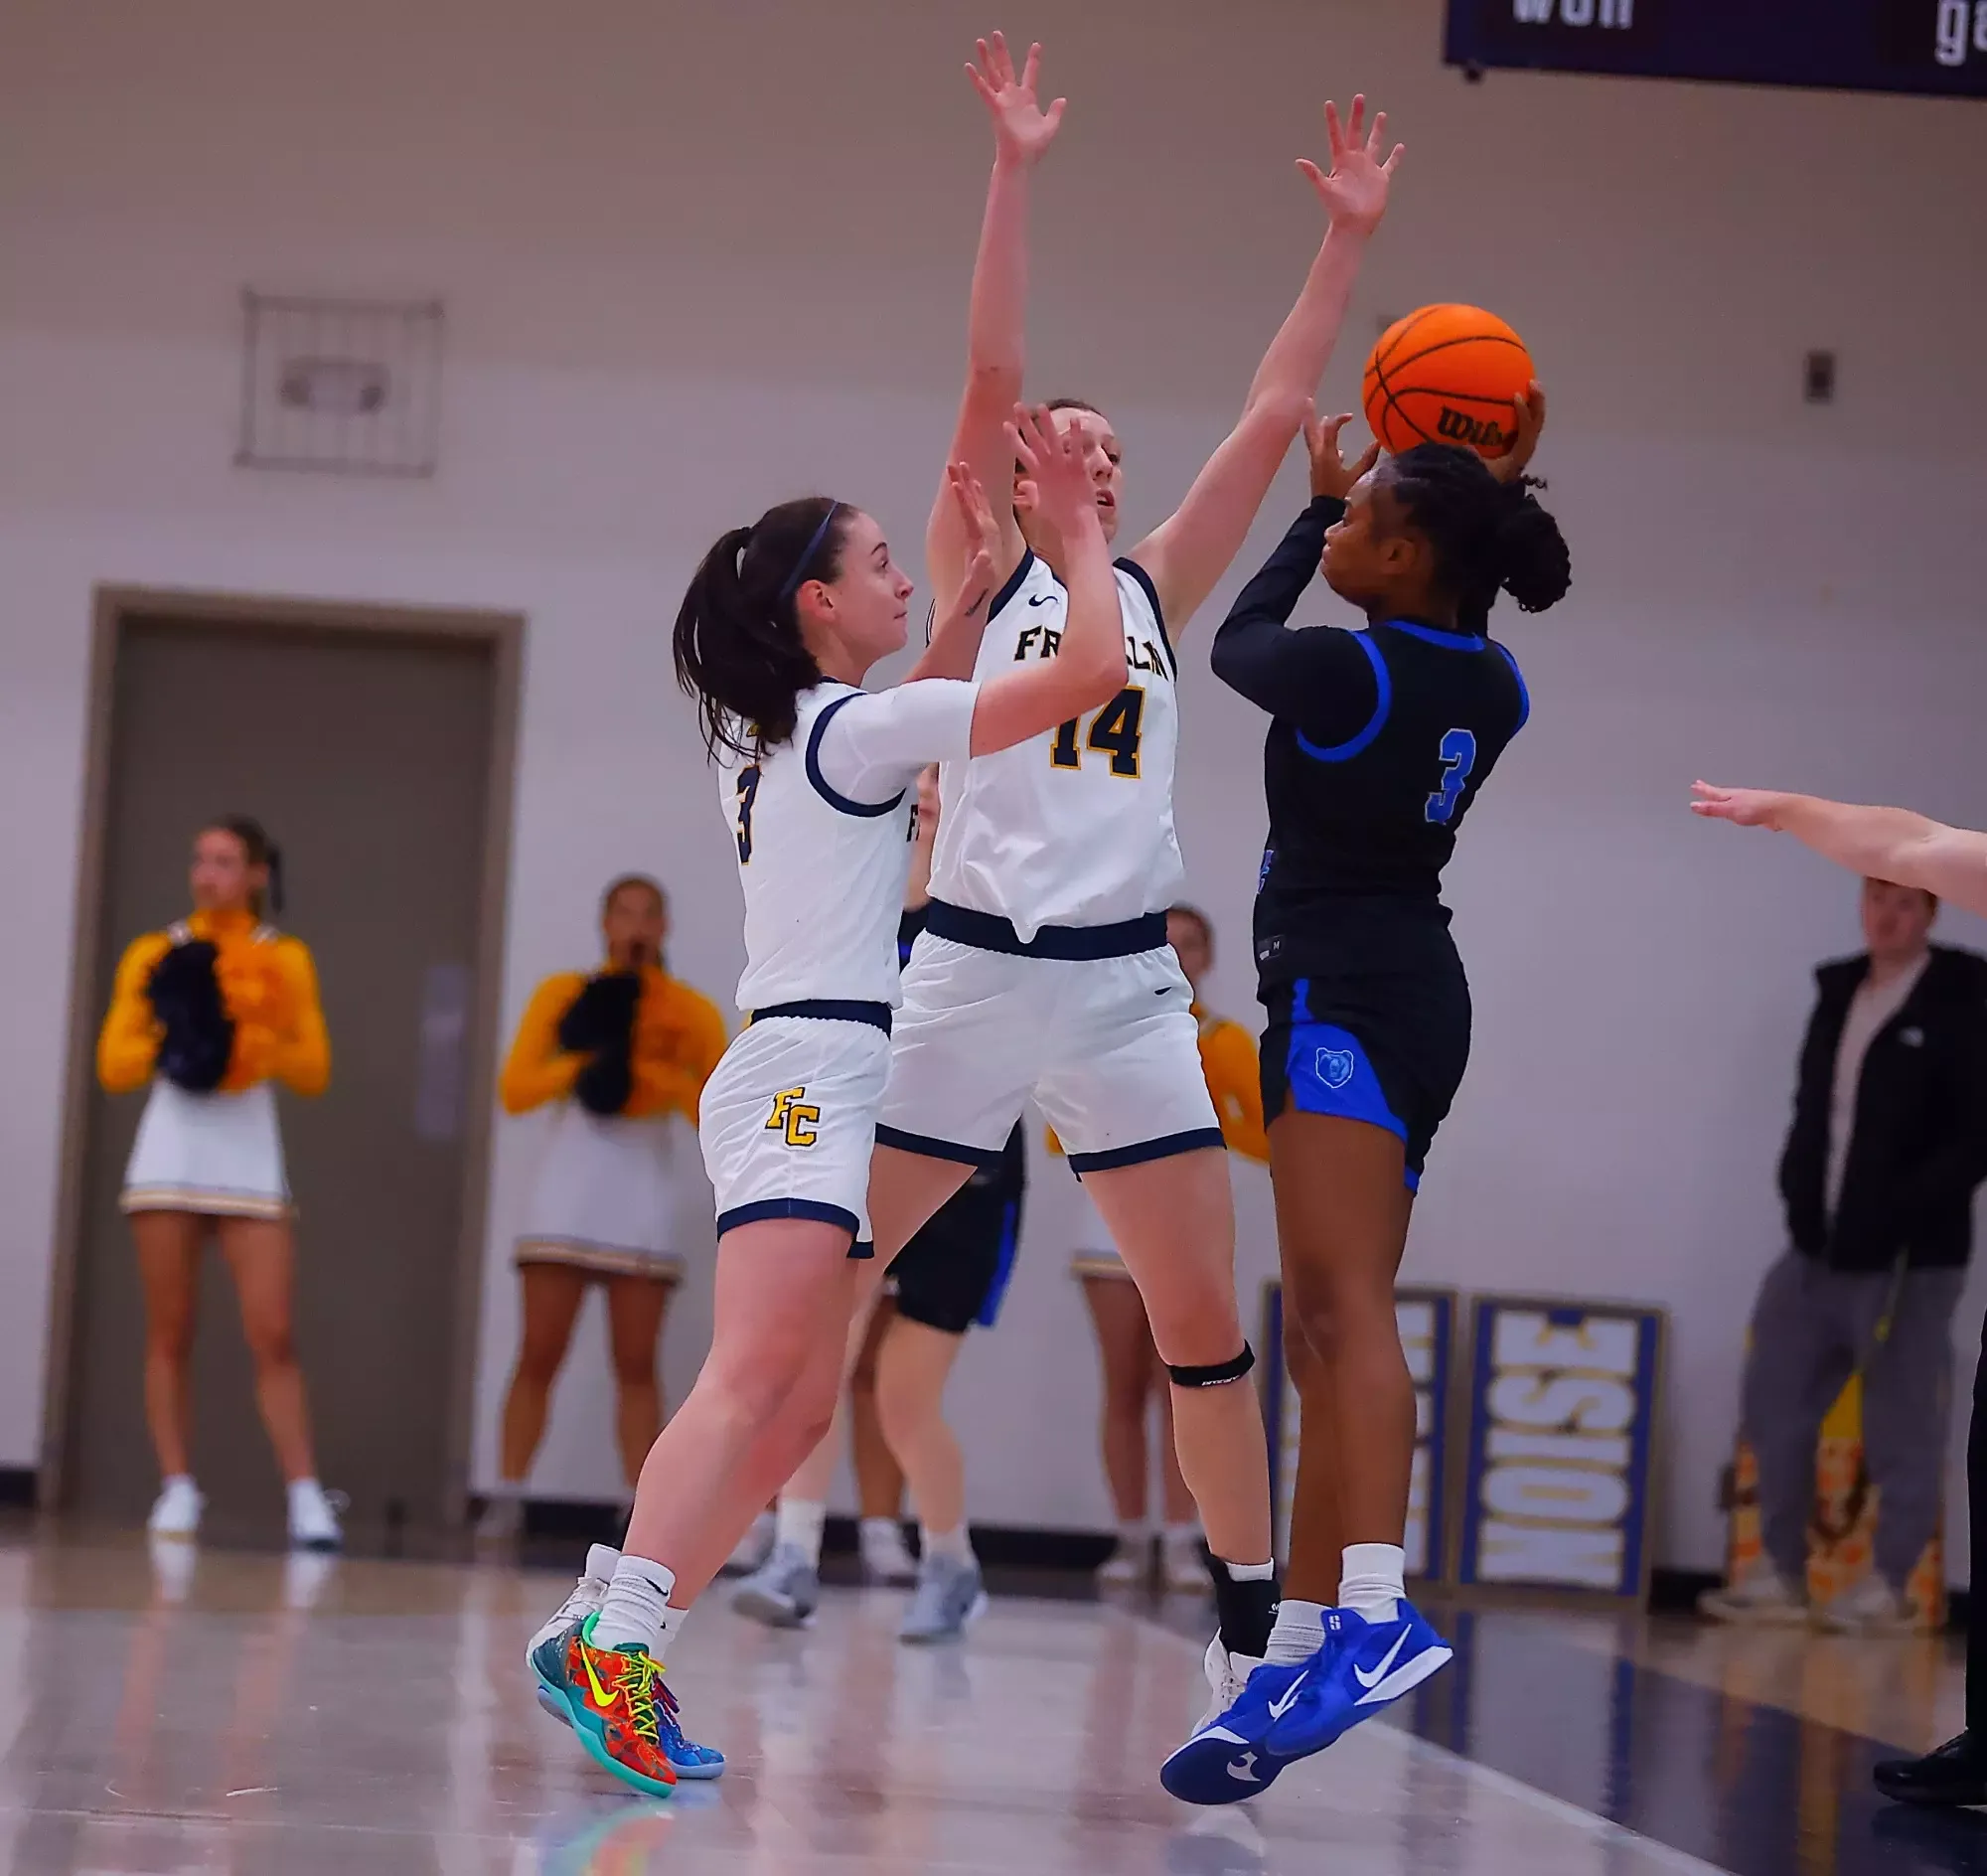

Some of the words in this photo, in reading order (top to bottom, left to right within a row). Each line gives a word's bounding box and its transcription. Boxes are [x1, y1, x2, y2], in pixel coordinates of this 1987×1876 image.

[1050, 685, 1146, 779] 14
[1425, 727, 1476, 825] 3
[764, 1086, 821, 1148] FC
[1475, 1309, 1641, 1589] NOISE
